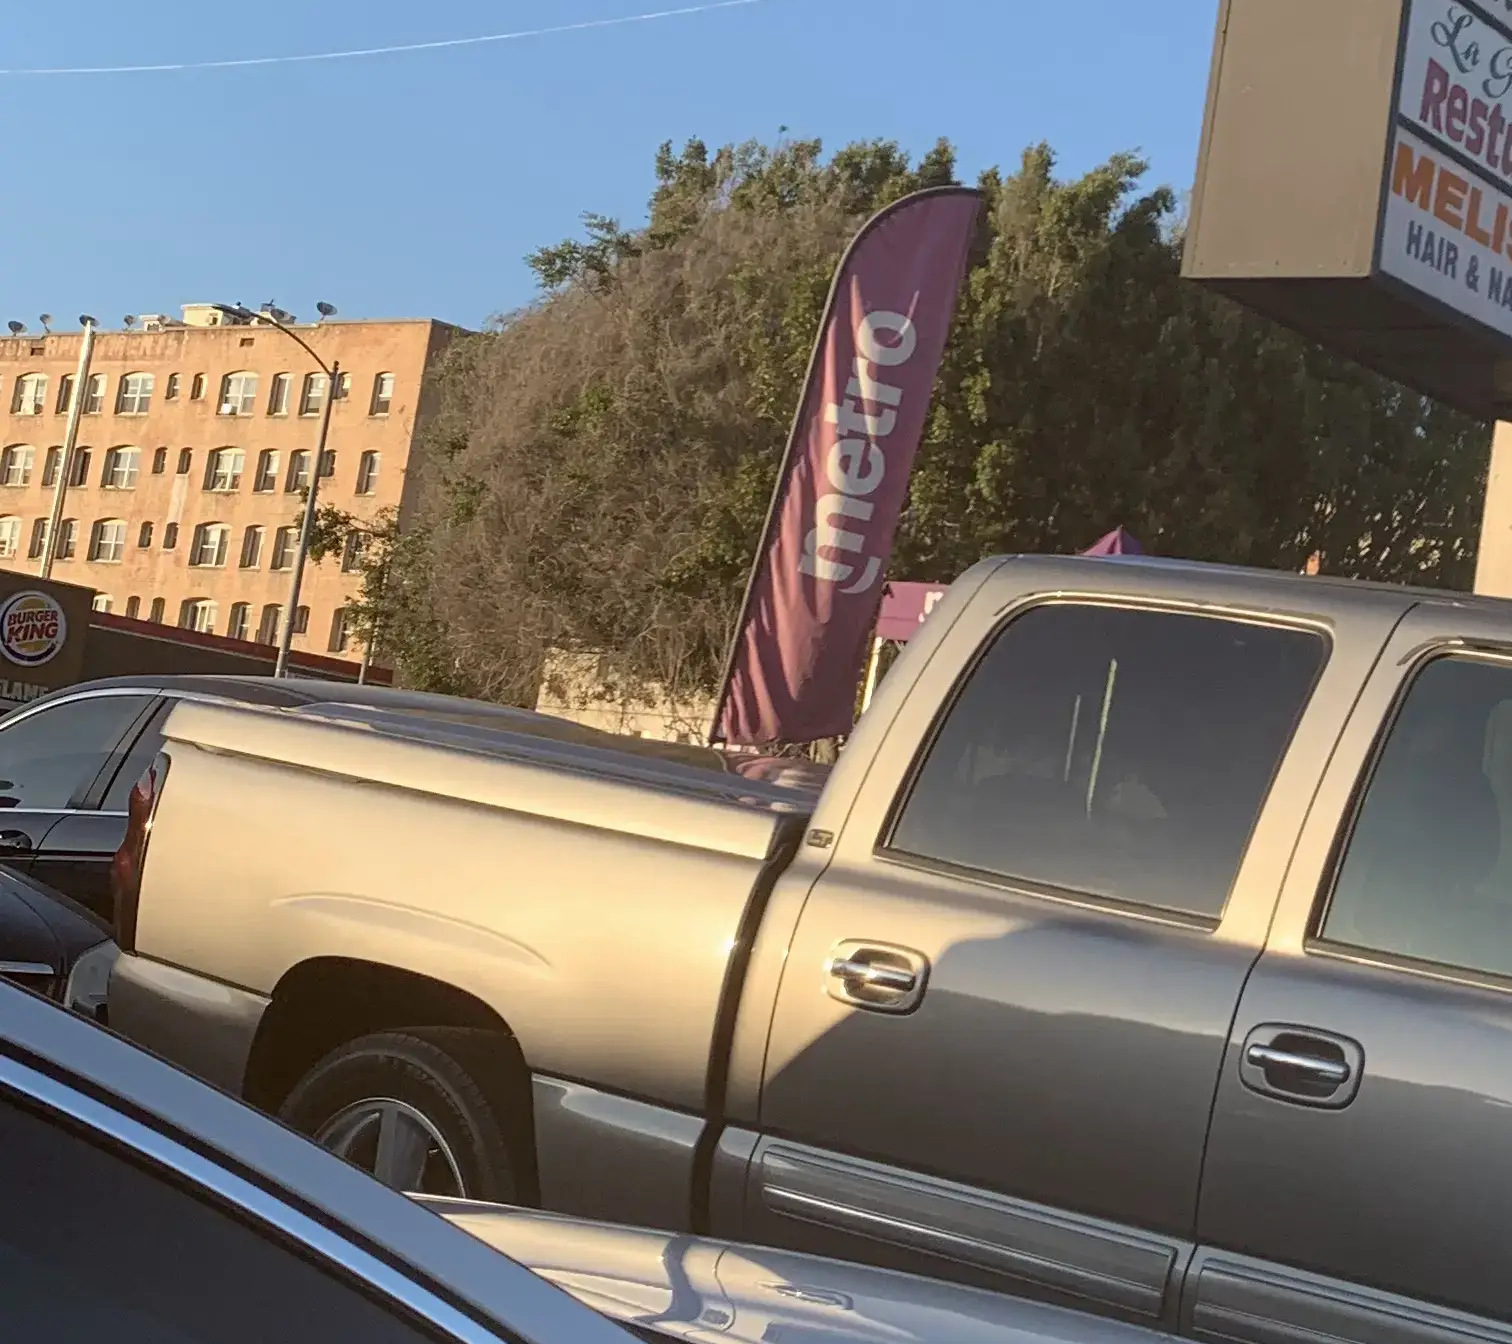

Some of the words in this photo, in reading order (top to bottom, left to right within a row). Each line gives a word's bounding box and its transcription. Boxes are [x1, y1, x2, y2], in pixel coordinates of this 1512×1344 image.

[1430, 6, 1481, 74] La
[1405, 220, 1459, 280] HAIR
[1465, 255, 1480, 294] &
[798, 310, 919, 595] metro
[7, 610, 59, 627] BURGER
[7, 622, 59, 644] KING
